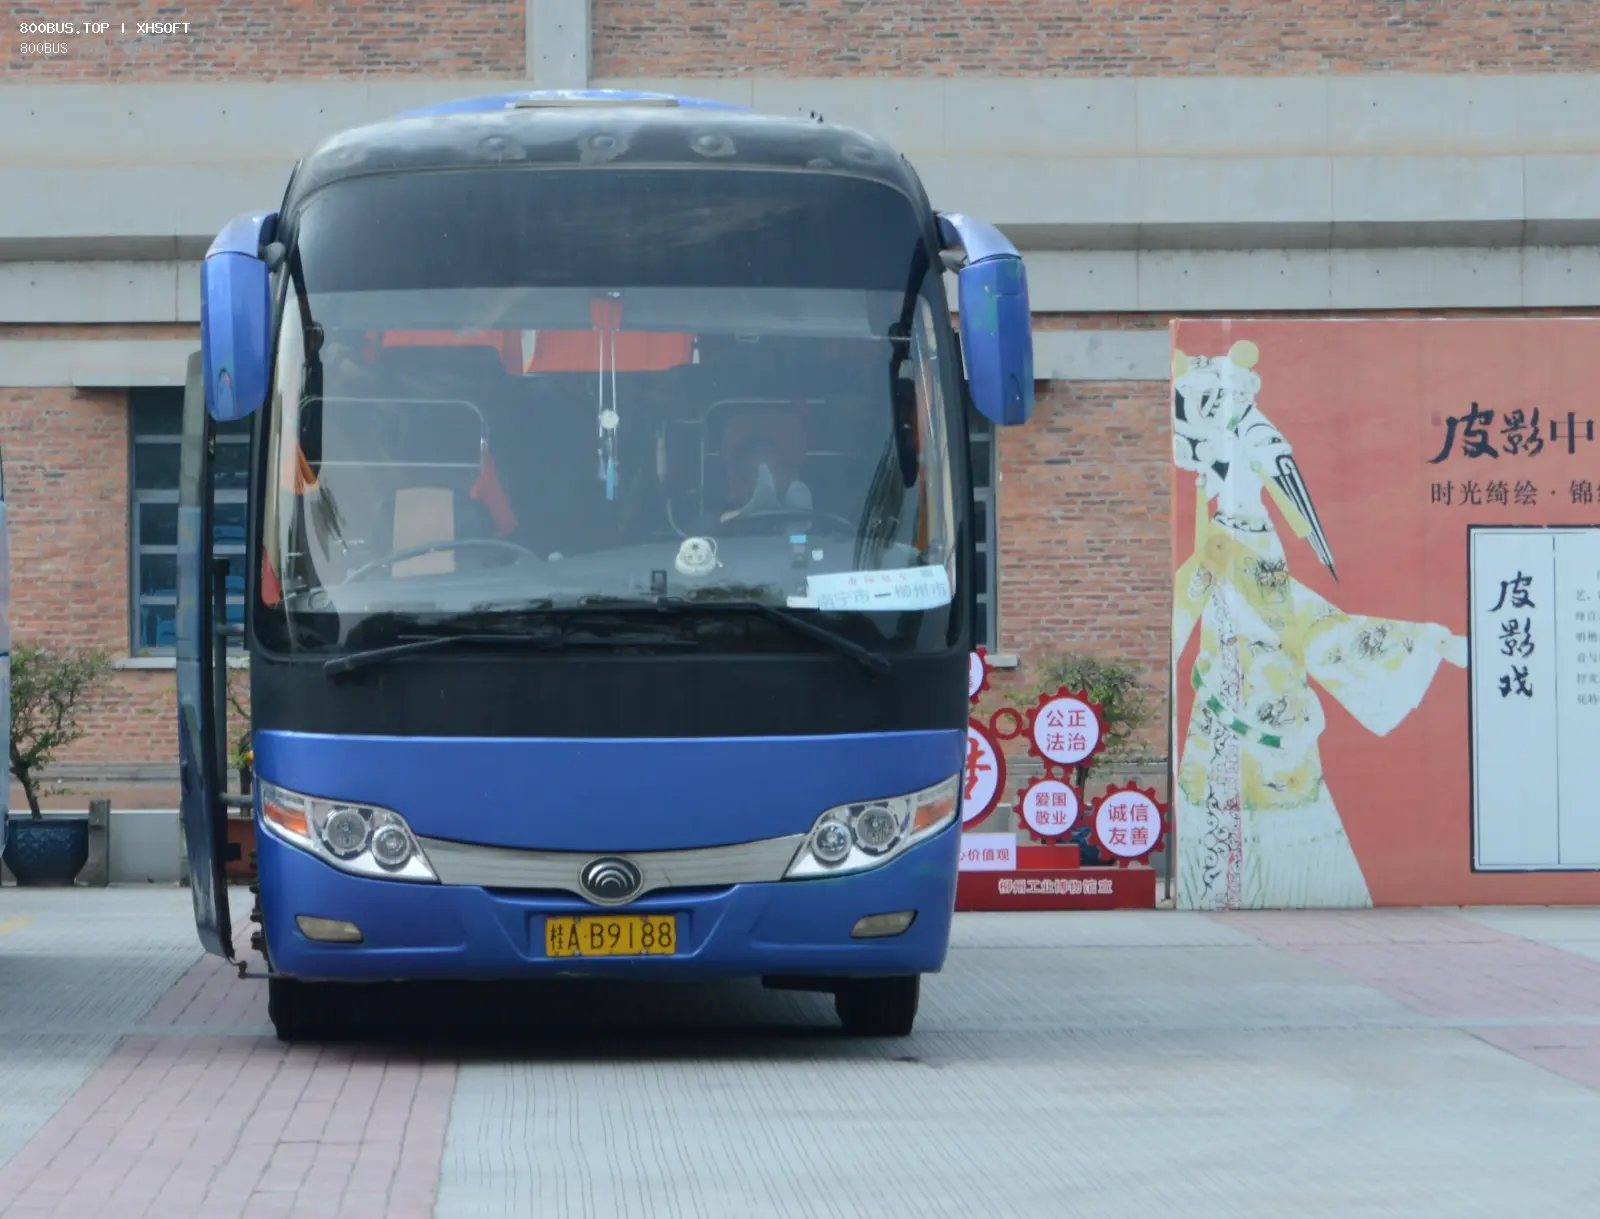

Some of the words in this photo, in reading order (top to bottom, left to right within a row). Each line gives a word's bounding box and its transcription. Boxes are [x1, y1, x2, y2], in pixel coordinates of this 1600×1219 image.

[1427, 402, 1594, 464] 皮影中
[1430, 479, 1600, 506] 时光绮绘·锦
[1488, 571, 1536, 698] 皮影戏
[1046, 709, 1087, 729] 公正
[1046, 732, 1087, 752] 法治
[1035, 792, 1067, 807] 爱国
[1035, 811, 1067, 826] 敬业
[1108, 803, 1149, 823] 诚信
[1108, 827, 1149, 846] 友善
[960, 848, 1010, 862] 价值观
